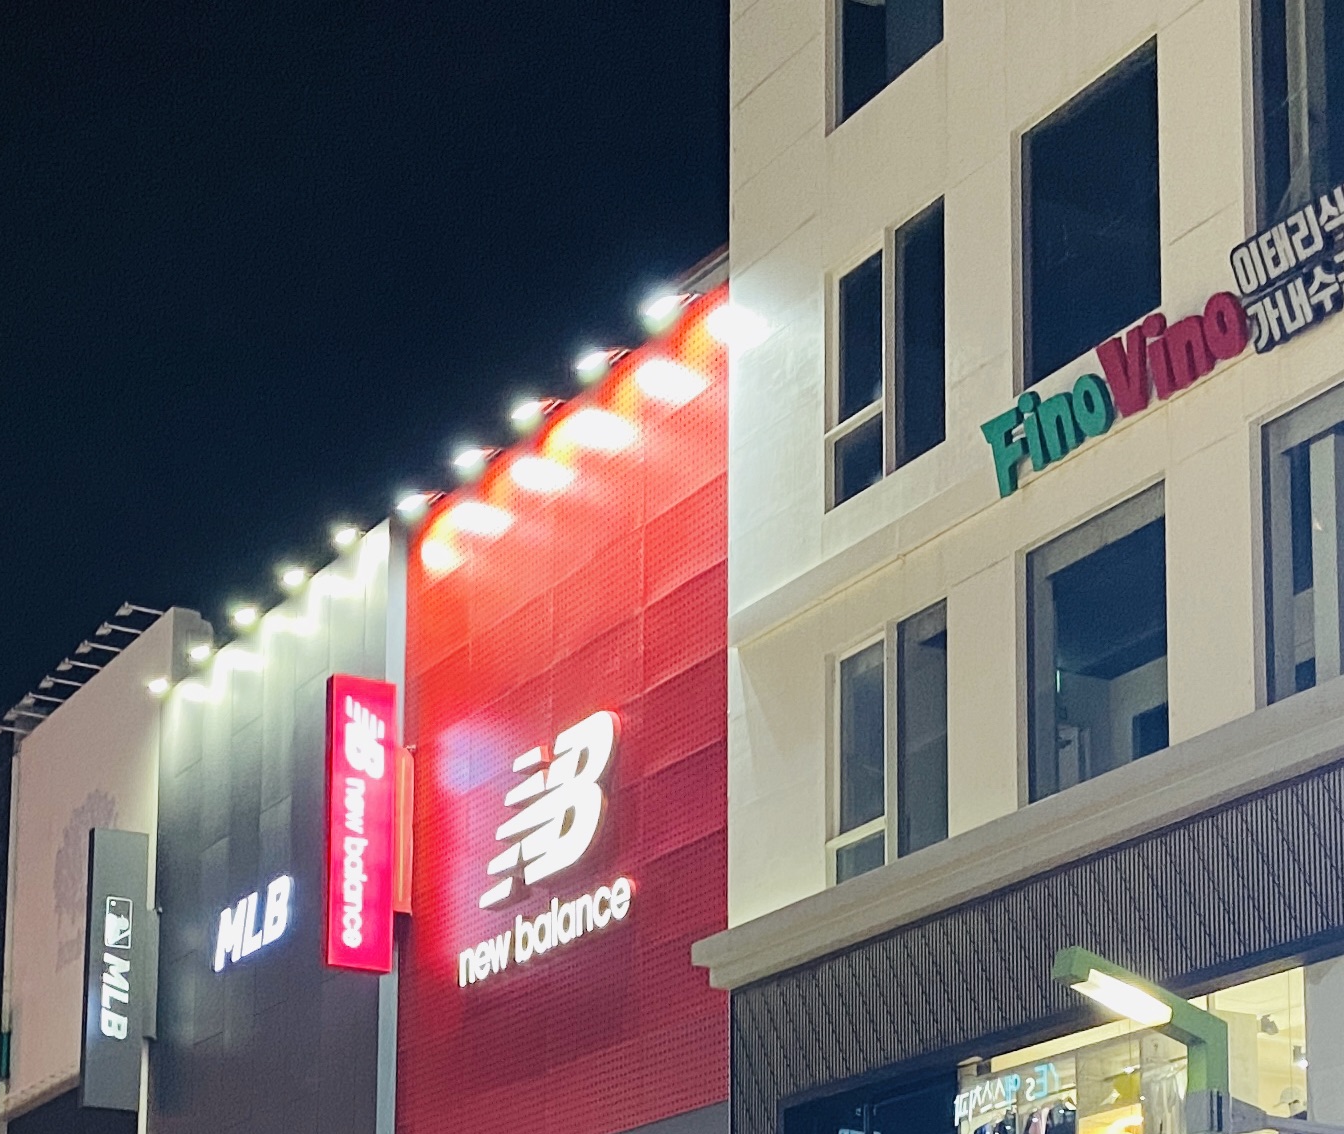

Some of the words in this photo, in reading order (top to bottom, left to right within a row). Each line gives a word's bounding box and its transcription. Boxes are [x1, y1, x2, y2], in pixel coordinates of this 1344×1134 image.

[344, 777, 366, 834] new
[212, 874, 294, 973] MLB
[342, 836, 369, 948] balance
[458, 936, 512, 988] new
[514, 876, 633, 965] balance
[99, 952, 133, 1041] MLB
